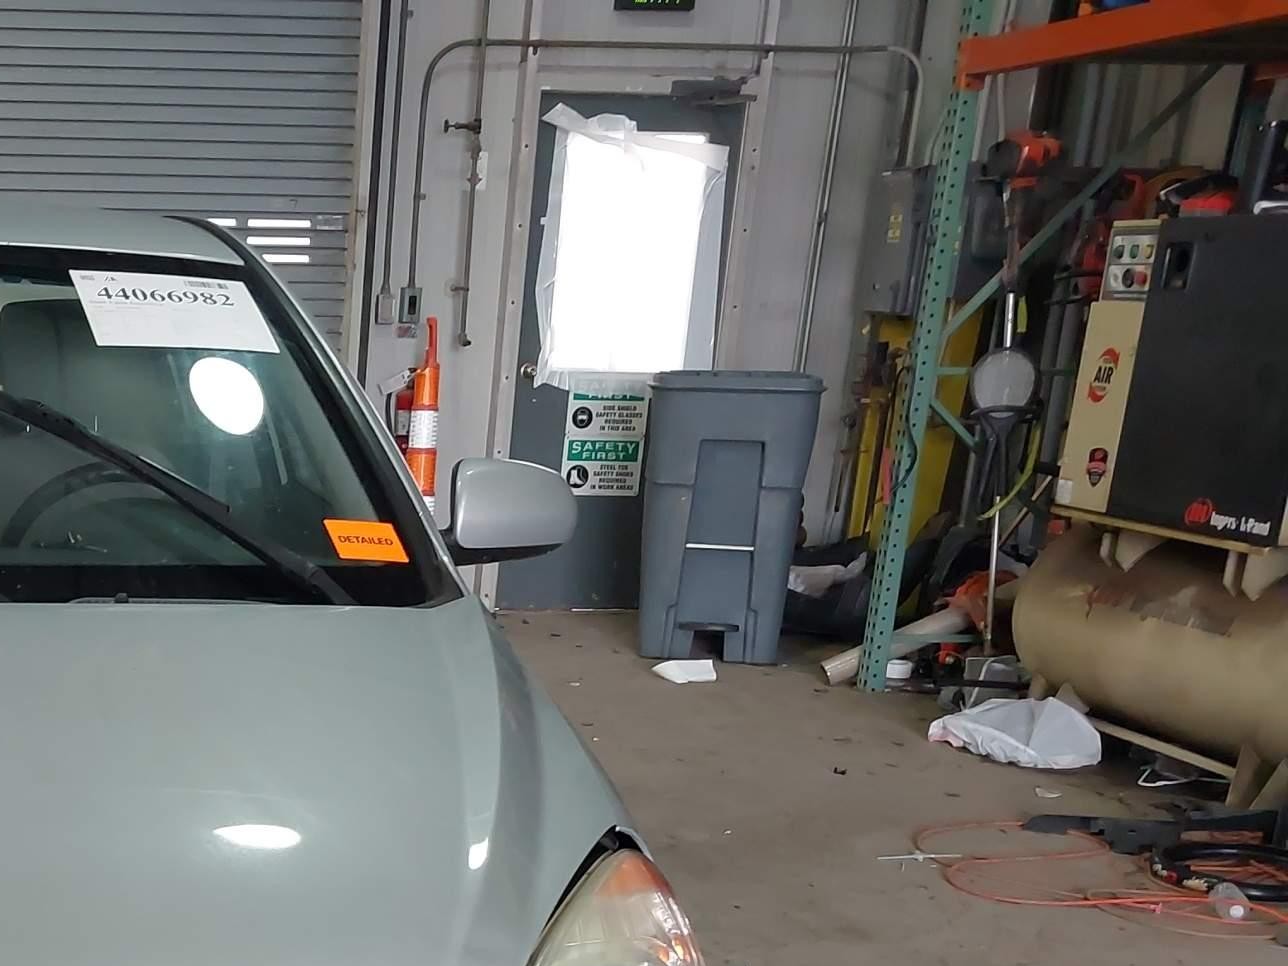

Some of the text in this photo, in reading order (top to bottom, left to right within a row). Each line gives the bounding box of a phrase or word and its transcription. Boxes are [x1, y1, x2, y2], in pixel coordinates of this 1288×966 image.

[96, 286, 235, 307] 44066982
[1093, 365, 1114, 385] AIR
[572, 441, 636, 454] SAFETY
[582, 452, 626, 460] FIRST
[337, 535, 394, 546] DETAILED
